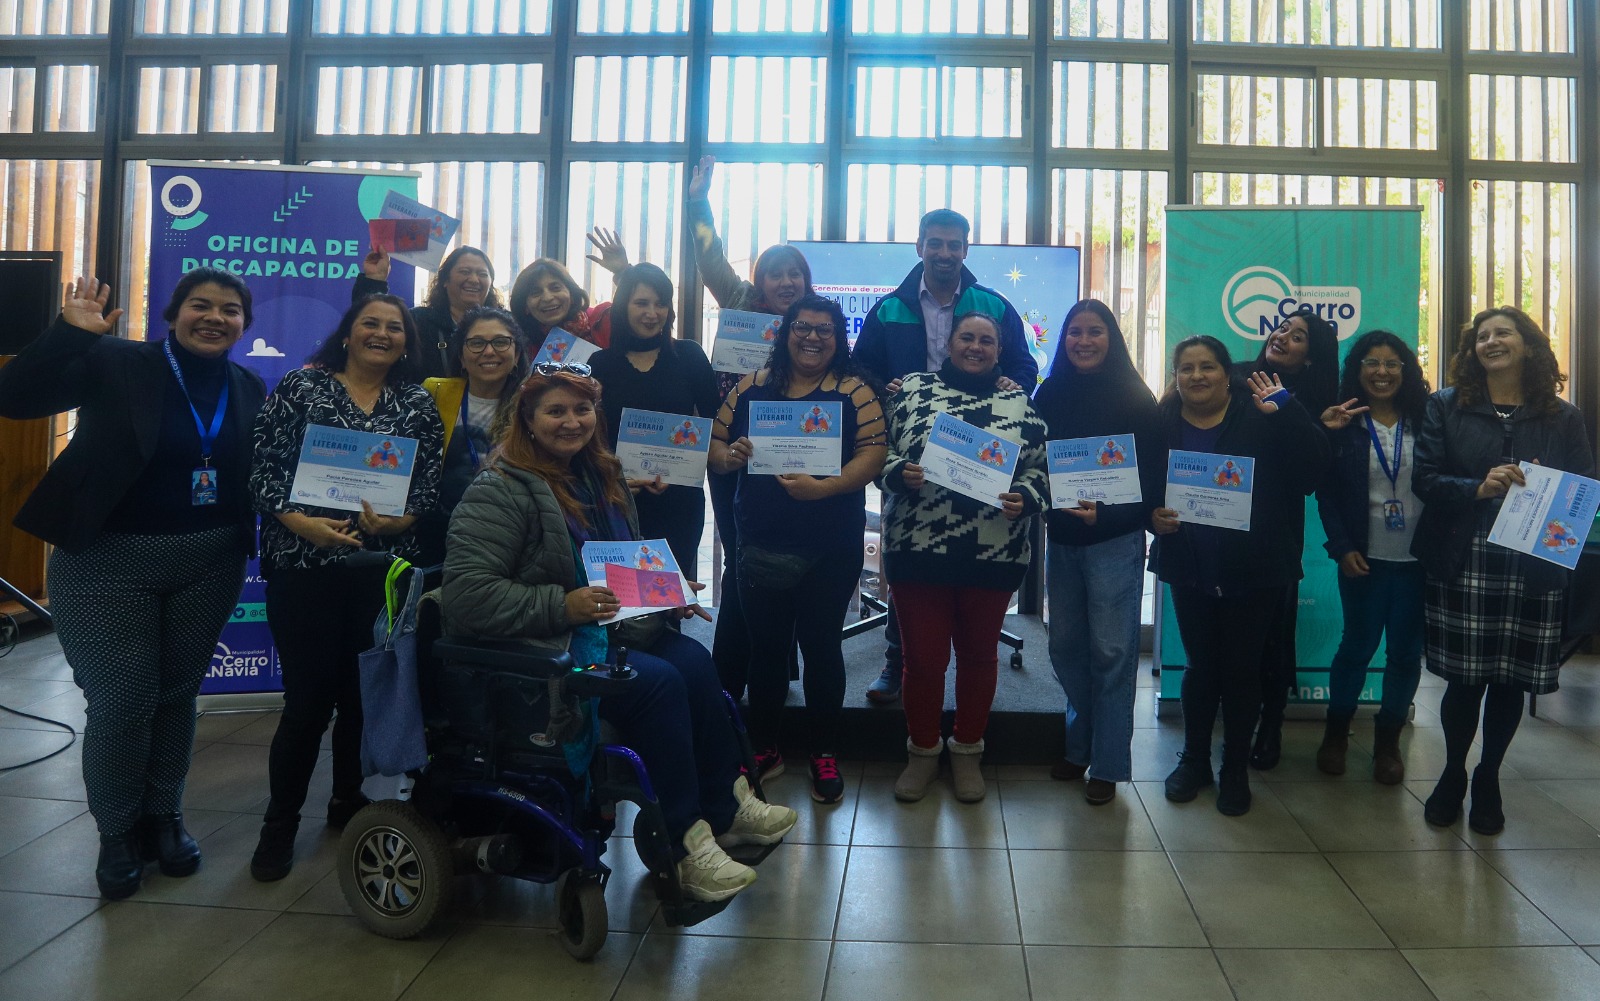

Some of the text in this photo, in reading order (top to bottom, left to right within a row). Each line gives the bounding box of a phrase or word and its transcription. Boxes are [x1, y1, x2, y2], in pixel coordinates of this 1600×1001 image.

[388, 202, 418, 218] LITERARIO
[207, 235, 359, 256] OFICINA DE
[182, 257, 362, 279] DISCAPACIDA
[1294, 290, 1350, 299] Municipalidad
[1278, 298, 1355, 320] Cerro
[724, 319, 755, 329] LITERARIO
[627, 420, 663, 431] LITERARIO
[939, 424, 973, 444] LITERARIO
[312, 438, 357, 452] LITERARIO
[1053, 449, 1088, 459] LITERARIO
[1174, 462, 1207, 472] LITERARIO
[1568, 482, 1587, 518] LITERARIO
[590, 555, 625, 563] LITERARIO
[250, 608, 266, 618] @C
[222, 655, 269, 668] Cerro
[211, 665, 259, 678] Navia
